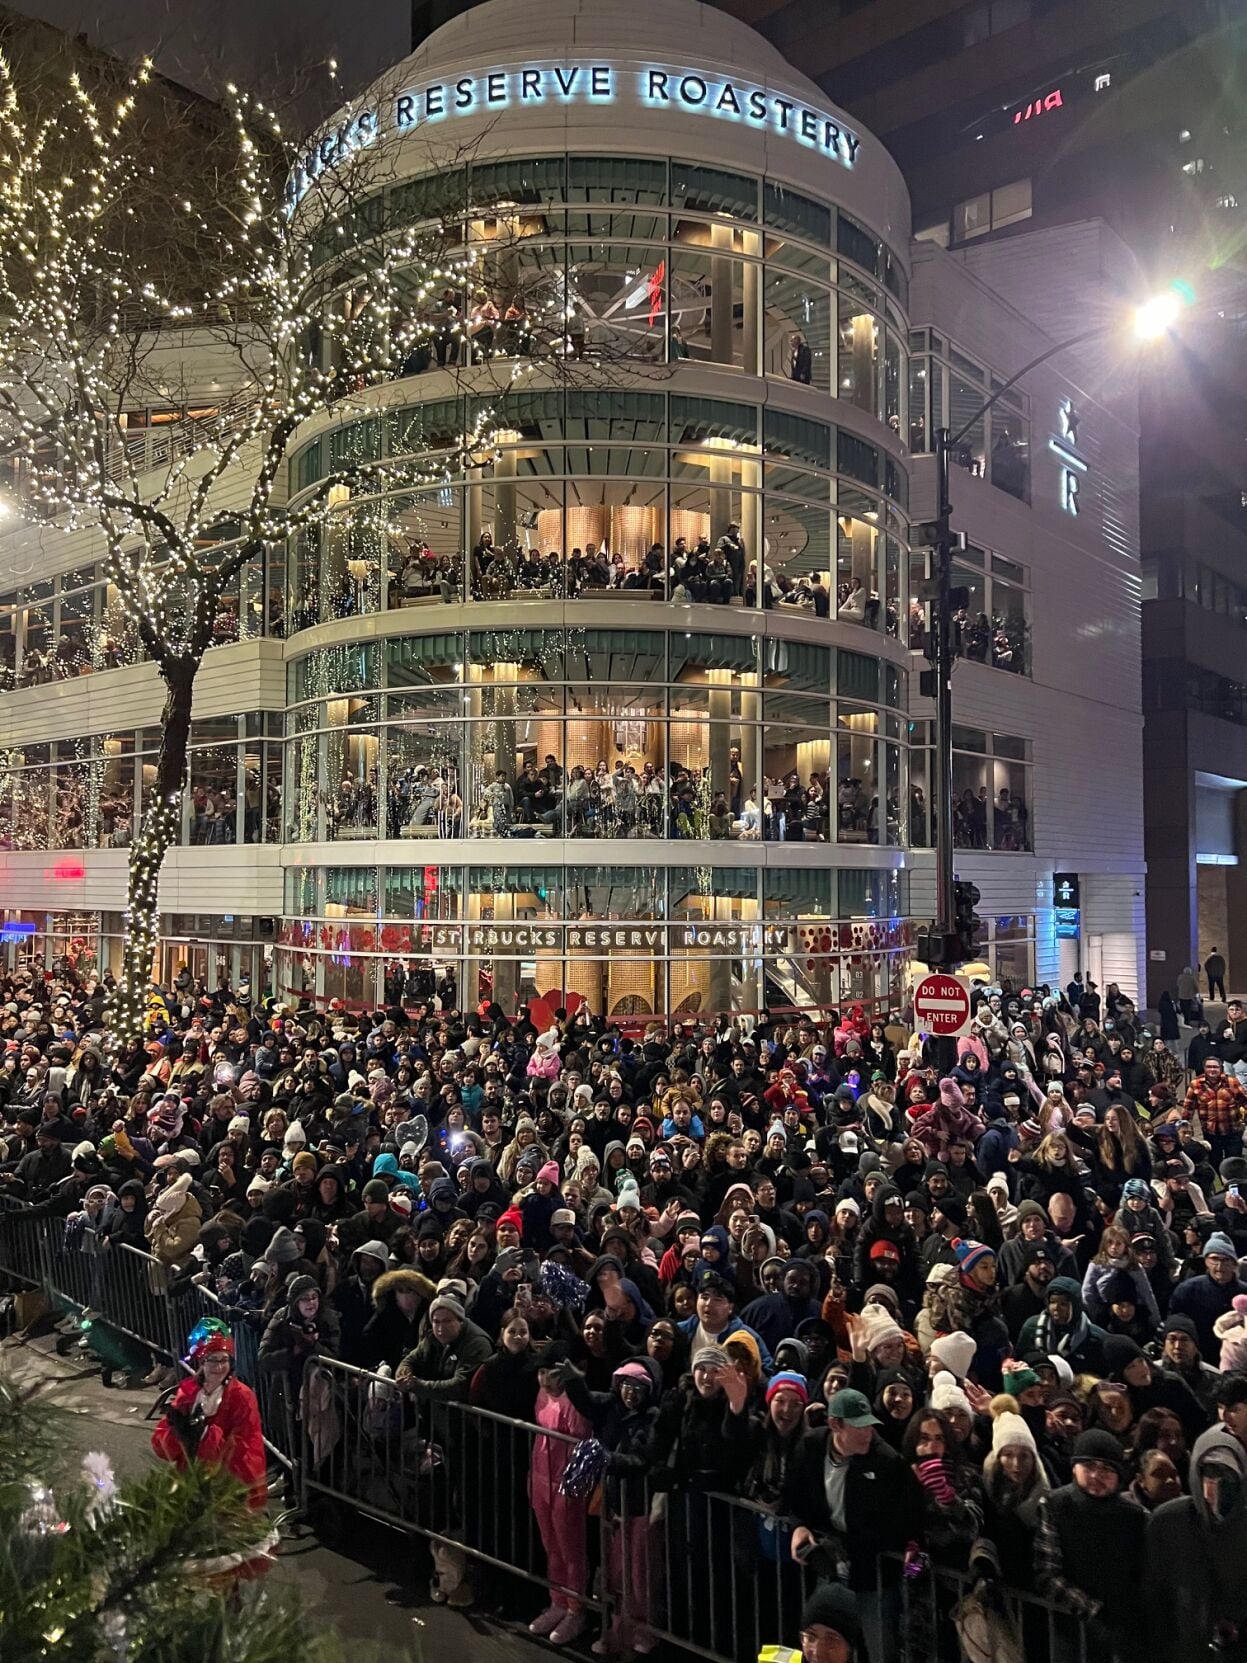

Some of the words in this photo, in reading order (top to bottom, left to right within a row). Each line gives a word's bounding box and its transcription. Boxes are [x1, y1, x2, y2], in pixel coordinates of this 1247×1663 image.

[397, 67, 611, 127] RESERVE
[649, 70, 860, 163] ROASTERY
[1063, 469, 1080, 515] R
[855, 971, 863, 979] 03
[921, 985, 935, 996] DO
[940, 986, 960, 997] NOT
[926, 1012, 958, 1024] ENTER
